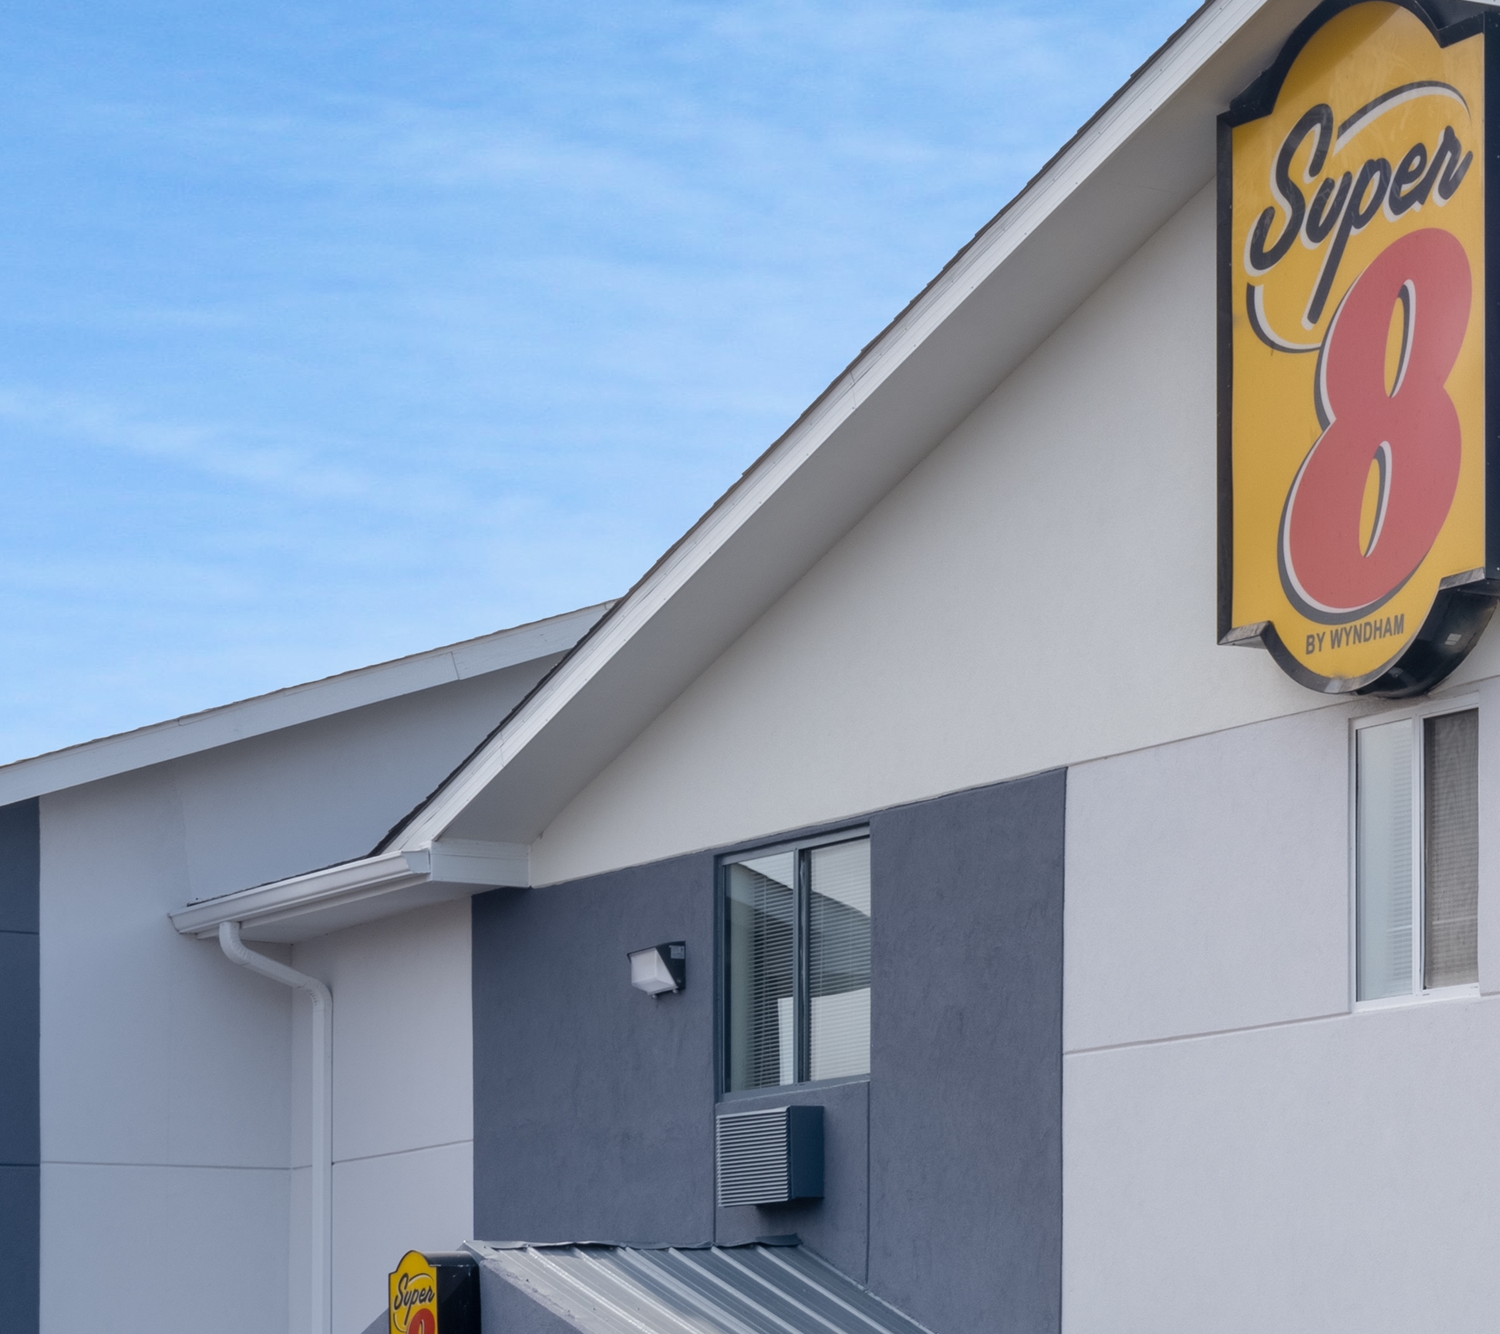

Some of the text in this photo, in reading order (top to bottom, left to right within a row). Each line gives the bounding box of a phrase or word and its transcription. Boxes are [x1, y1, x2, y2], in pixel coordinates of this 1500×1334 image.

[1246, 103, 1474, 331] Super
[1277, 227, 1472, 626] 8
[1305, 613, 1405, 656] BY WYNDHAM
[393, 1272, 435, 1326] Super
